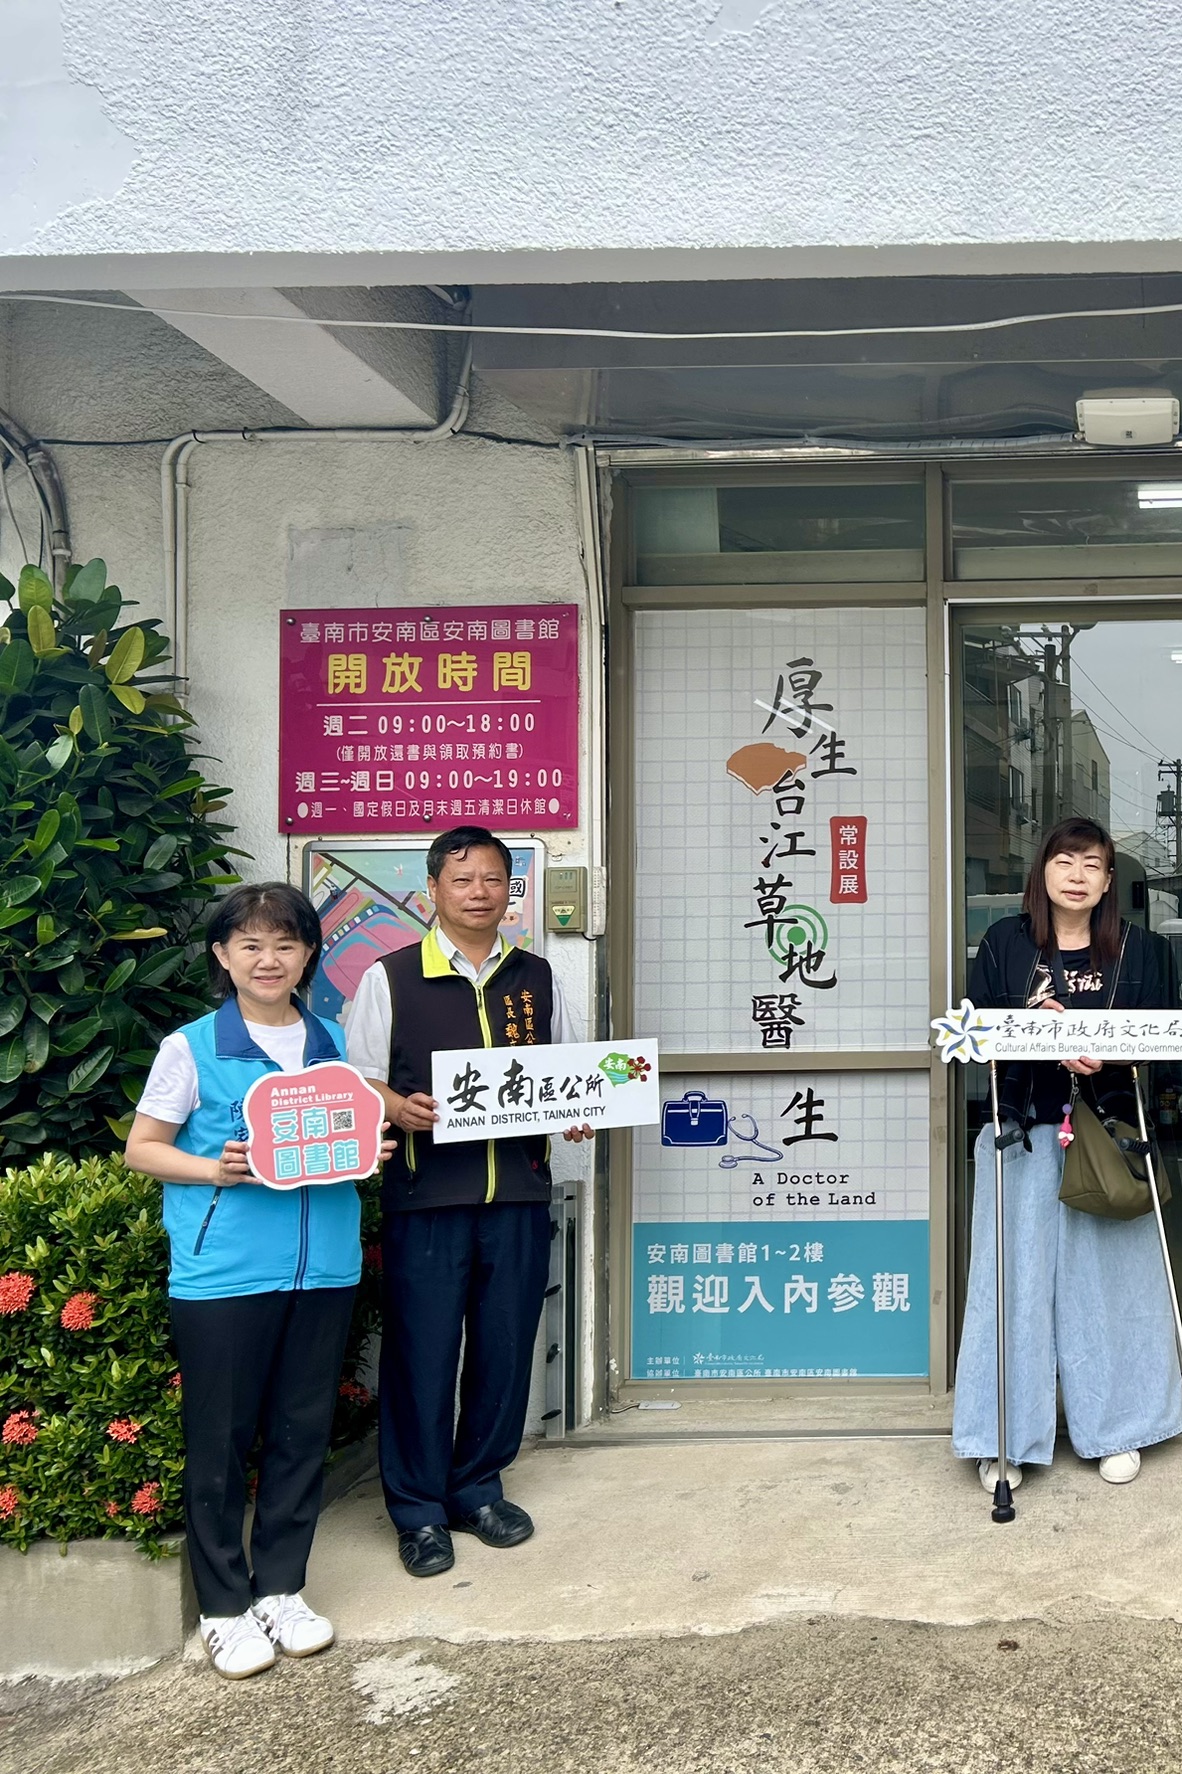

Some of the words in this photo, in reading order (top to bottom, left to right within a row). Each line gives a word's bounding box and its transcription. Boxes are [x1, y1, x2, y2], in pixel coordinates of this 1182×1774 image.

[299, 618, 560, 644] 臺南市安南區安南圖書館
[327, 651, 532, 694] 開放時間
[323, 714, 369, 737] 週二
[336, 742, 524, 762] (僅開放還書與領取預約書)
[838, 824, 859, 895] 常設展
[995, 1042, 1028, 1053] Cultural
[1029, 1042, 1056, 1053] Affairs
[1120, 1042, 1136, 1055] City
[603, 1058, 627, 1070] 安南
[271, 1085, 317, 1098] Annan
[447, 1058, 605, 1113] 安南區公所
[271, 1096, 314, 1107] District
[315, 1092, 354, 1102] Library
[271, 1107, 329, 1144] 安南
[447, 1116, 486, 1129] ANNAN
[491, 1112, 540, 1125] DISTRICT,
[543, 1108, 581, 1121] TAINAN
[583, 1106, 606, 1118] CITY
[273, 1139, 360, 1180] 圖書館
[752, 1172, 765, 1185] A
[777, 1171, 850, 1185] Doctor
[752, 1193, 776, 1206] of
[785, 1192, 821, 1206] the
[828, 1191, 877, 1206] Land
[647, 1241, 825, 1265] 安南圖書館1~2樓
